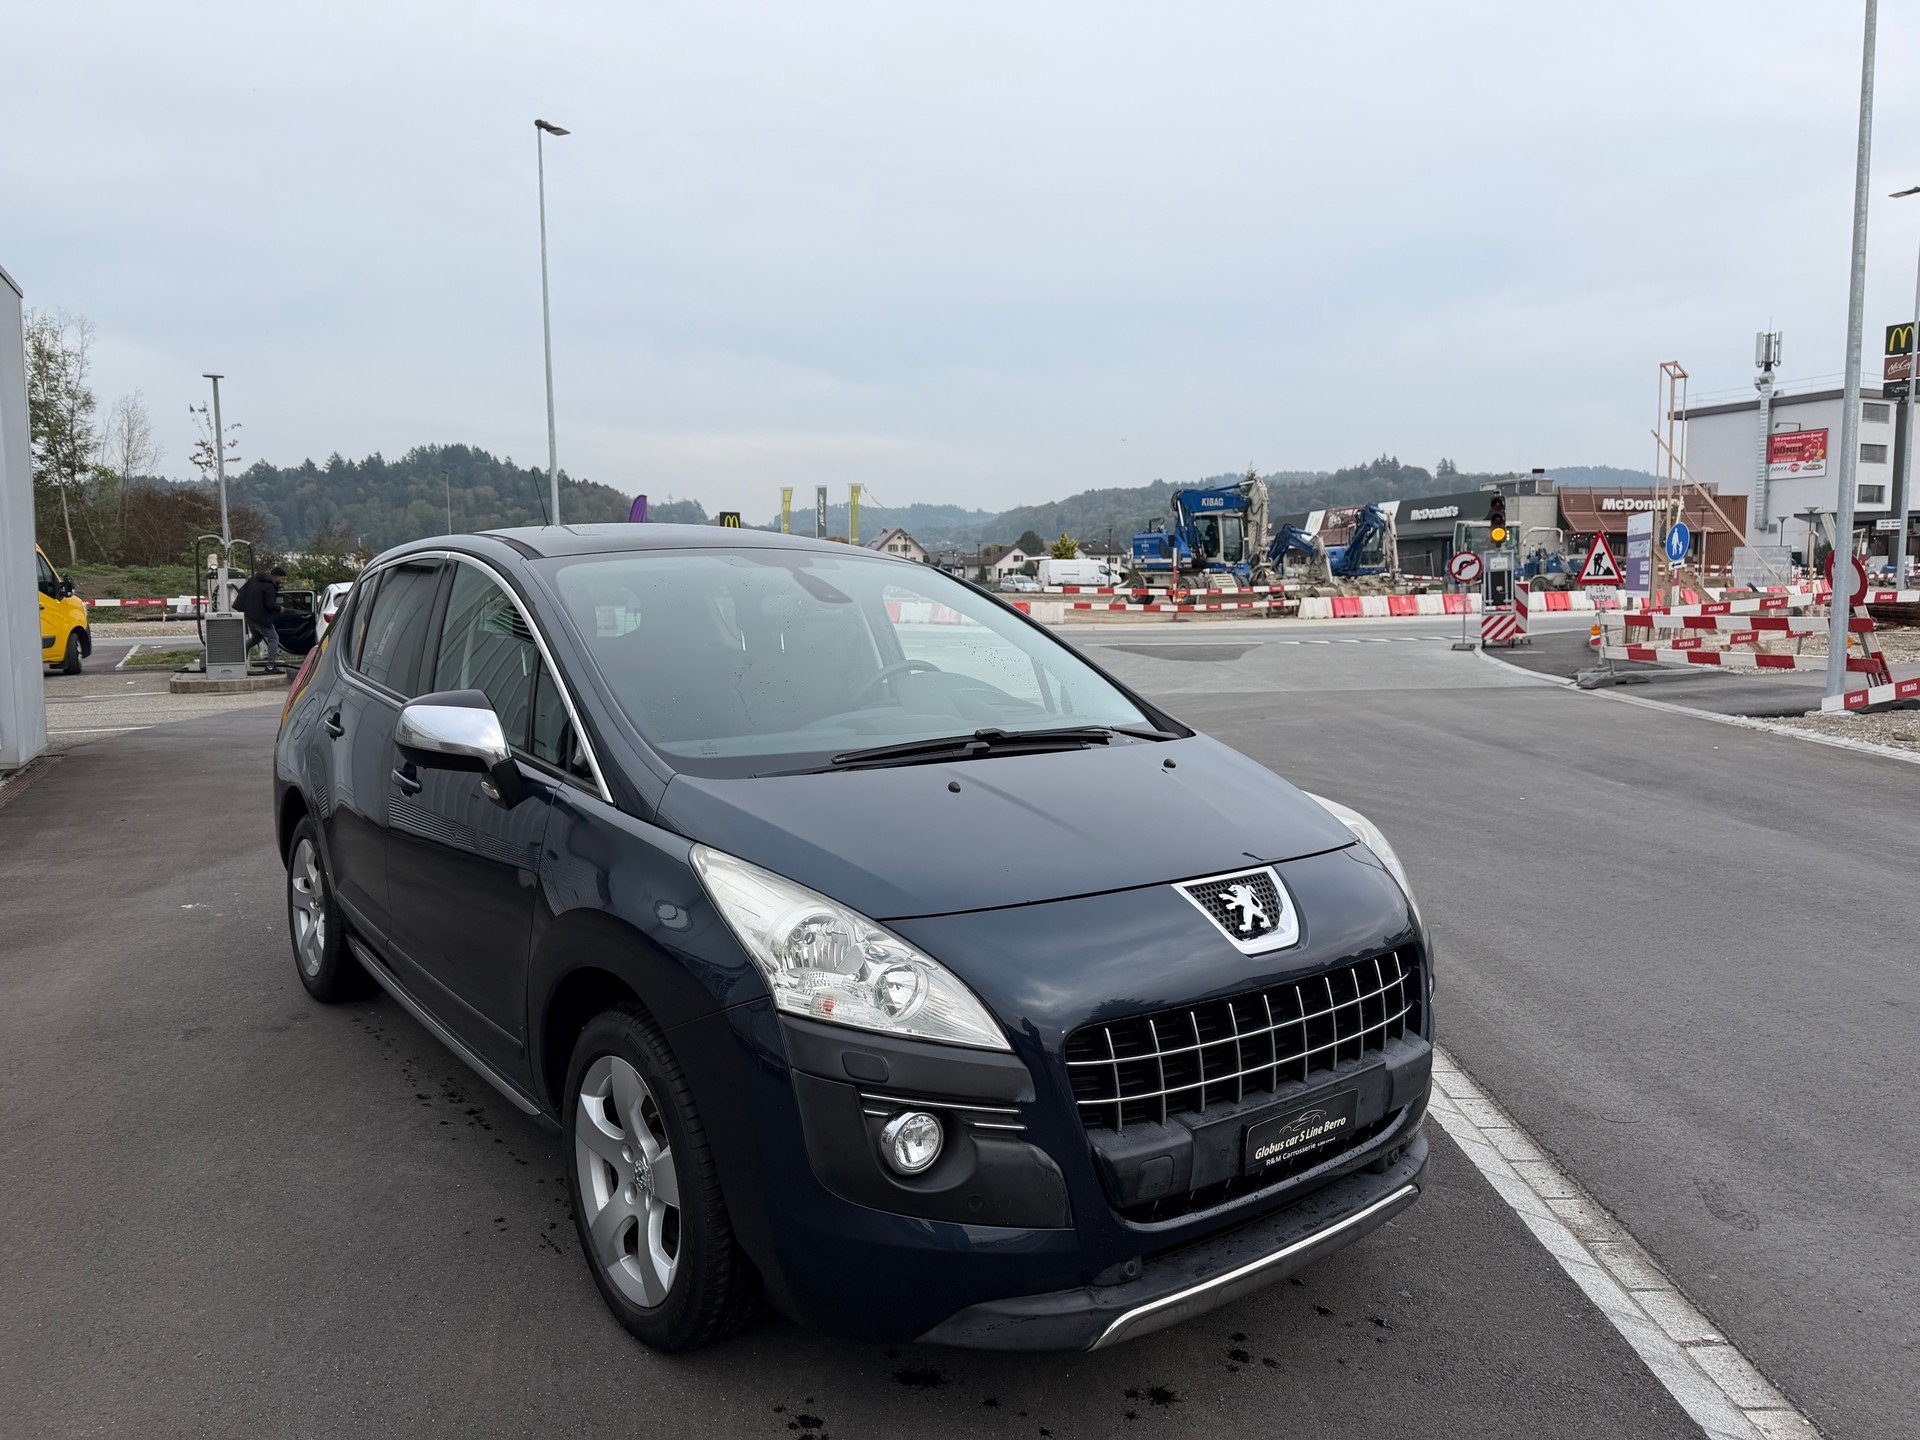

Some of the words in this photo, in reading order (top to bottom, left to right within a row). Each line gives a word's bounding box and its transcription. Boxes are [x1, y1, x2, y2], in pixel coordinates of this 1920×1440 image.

[1202, 498, 1224, 507] KIBAG
[1411, 505, 1459, 520] McDonald's
[1901, 683, 1918, 692] KIBAG
[1849, 695, 1863, 703] KIBAG
[1255, 1141, 1285, 1160] Globus
[1285, 1134, 1299, 1148] car
[1299, 1130, 1306, 1142] S
[1305, 1126, 1322, 1140] Line
[1323, 1117, 1347, 1132] Berro
[1266, 1155, 1282, 1167] R&M
[1282, 1143, 1316, 1160] Carrosserie
